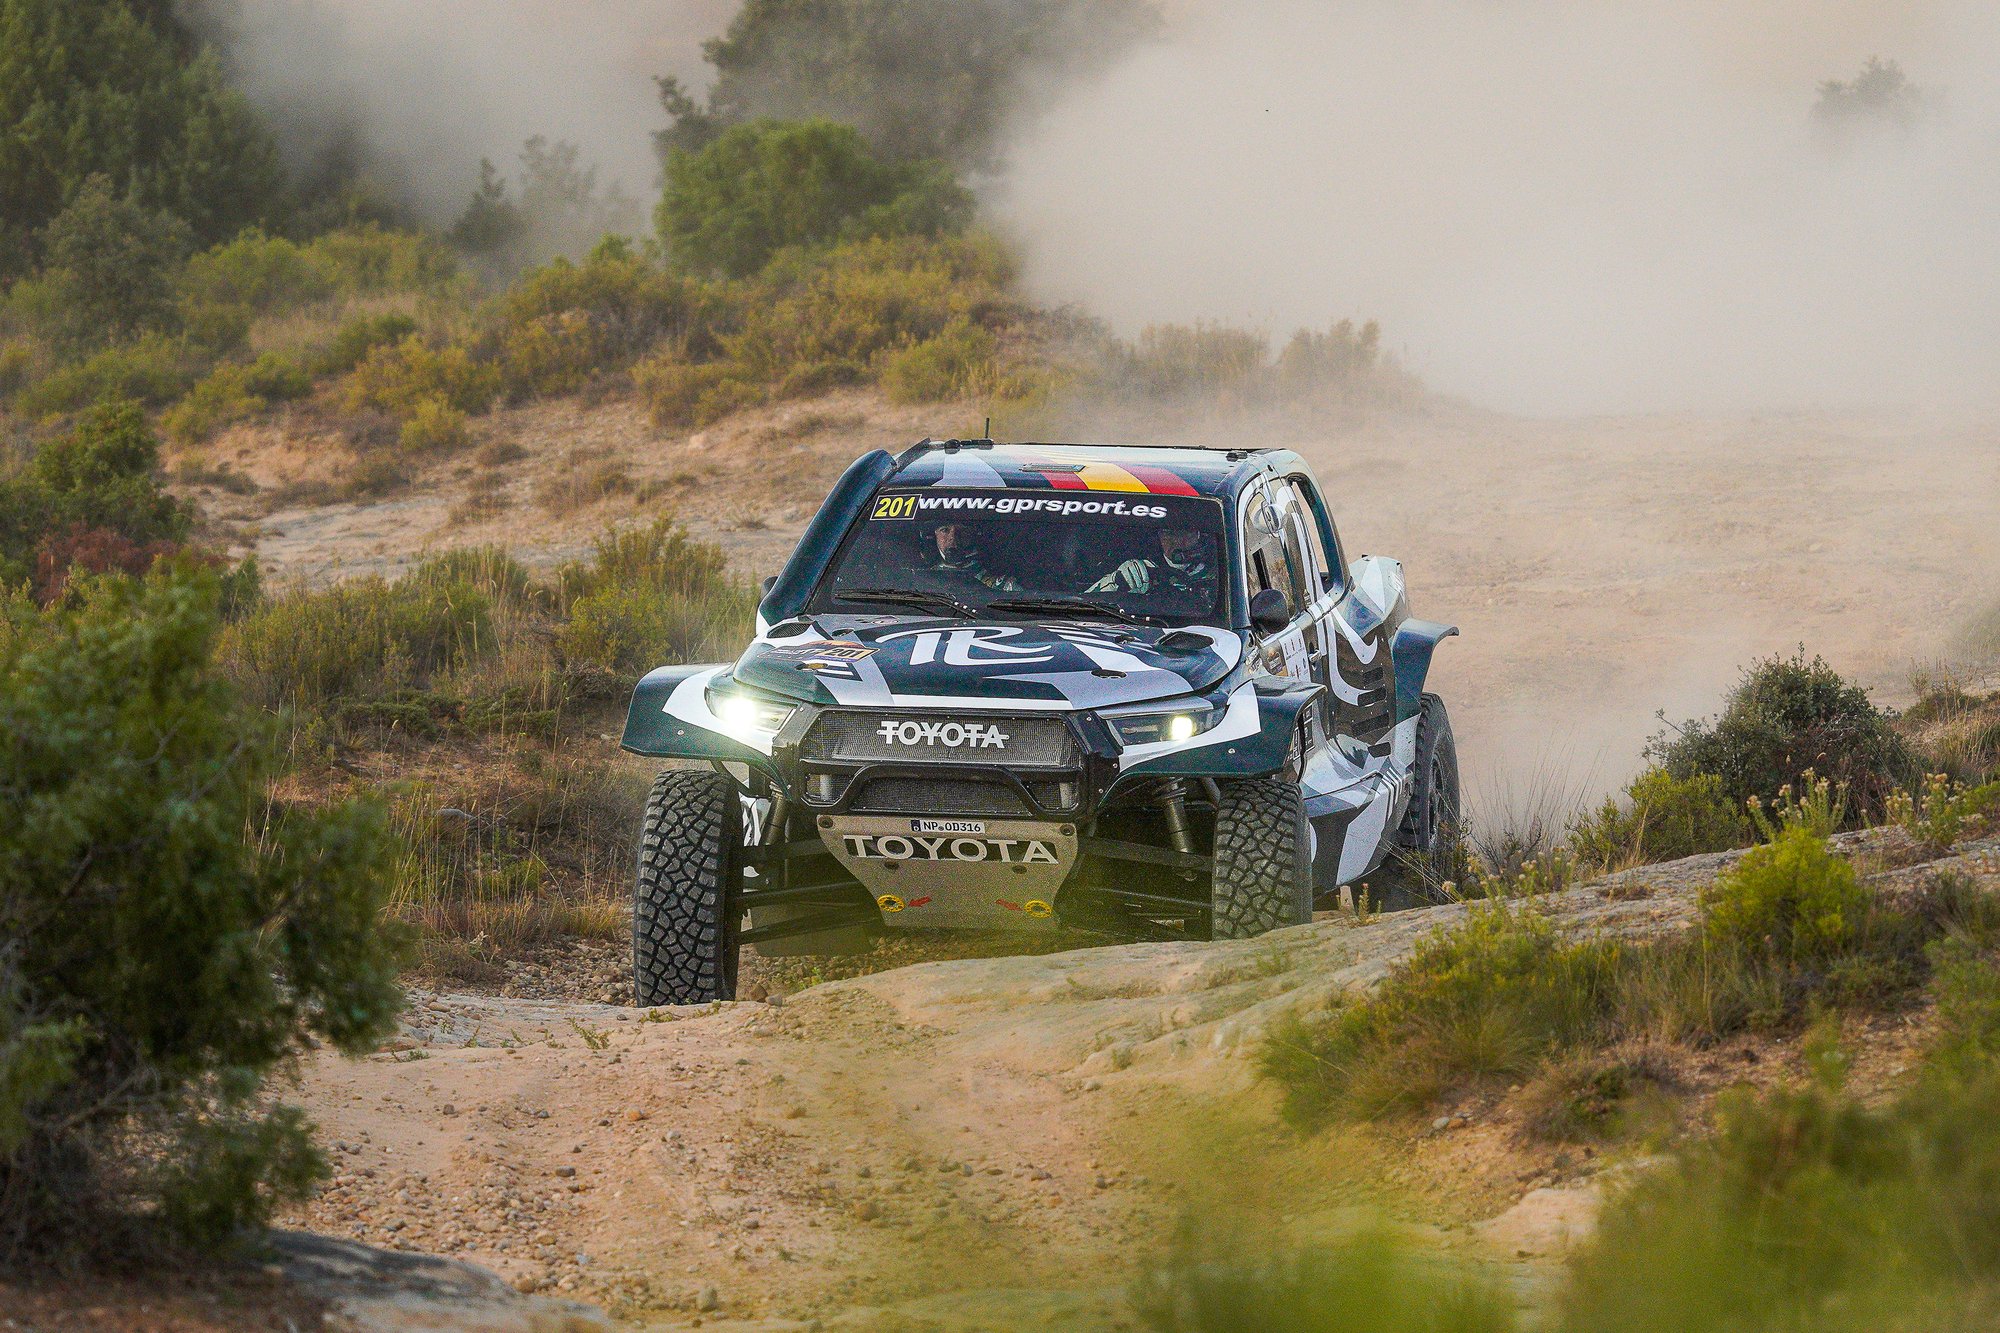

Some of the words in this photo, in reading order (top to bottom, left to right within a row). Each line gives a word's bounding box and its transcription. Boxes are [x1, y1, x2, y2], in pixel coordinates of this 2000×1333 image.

[874, 497, 916, 517] 201
[918, 494, 1168, 519] www.gprsport.es
[827, 648, 864, 658] 201
[878, 720, 1008, 748] TOYOTA
[923, 821, 938, 831] NP
[843, 834, 1059, 865] TOYOTA
